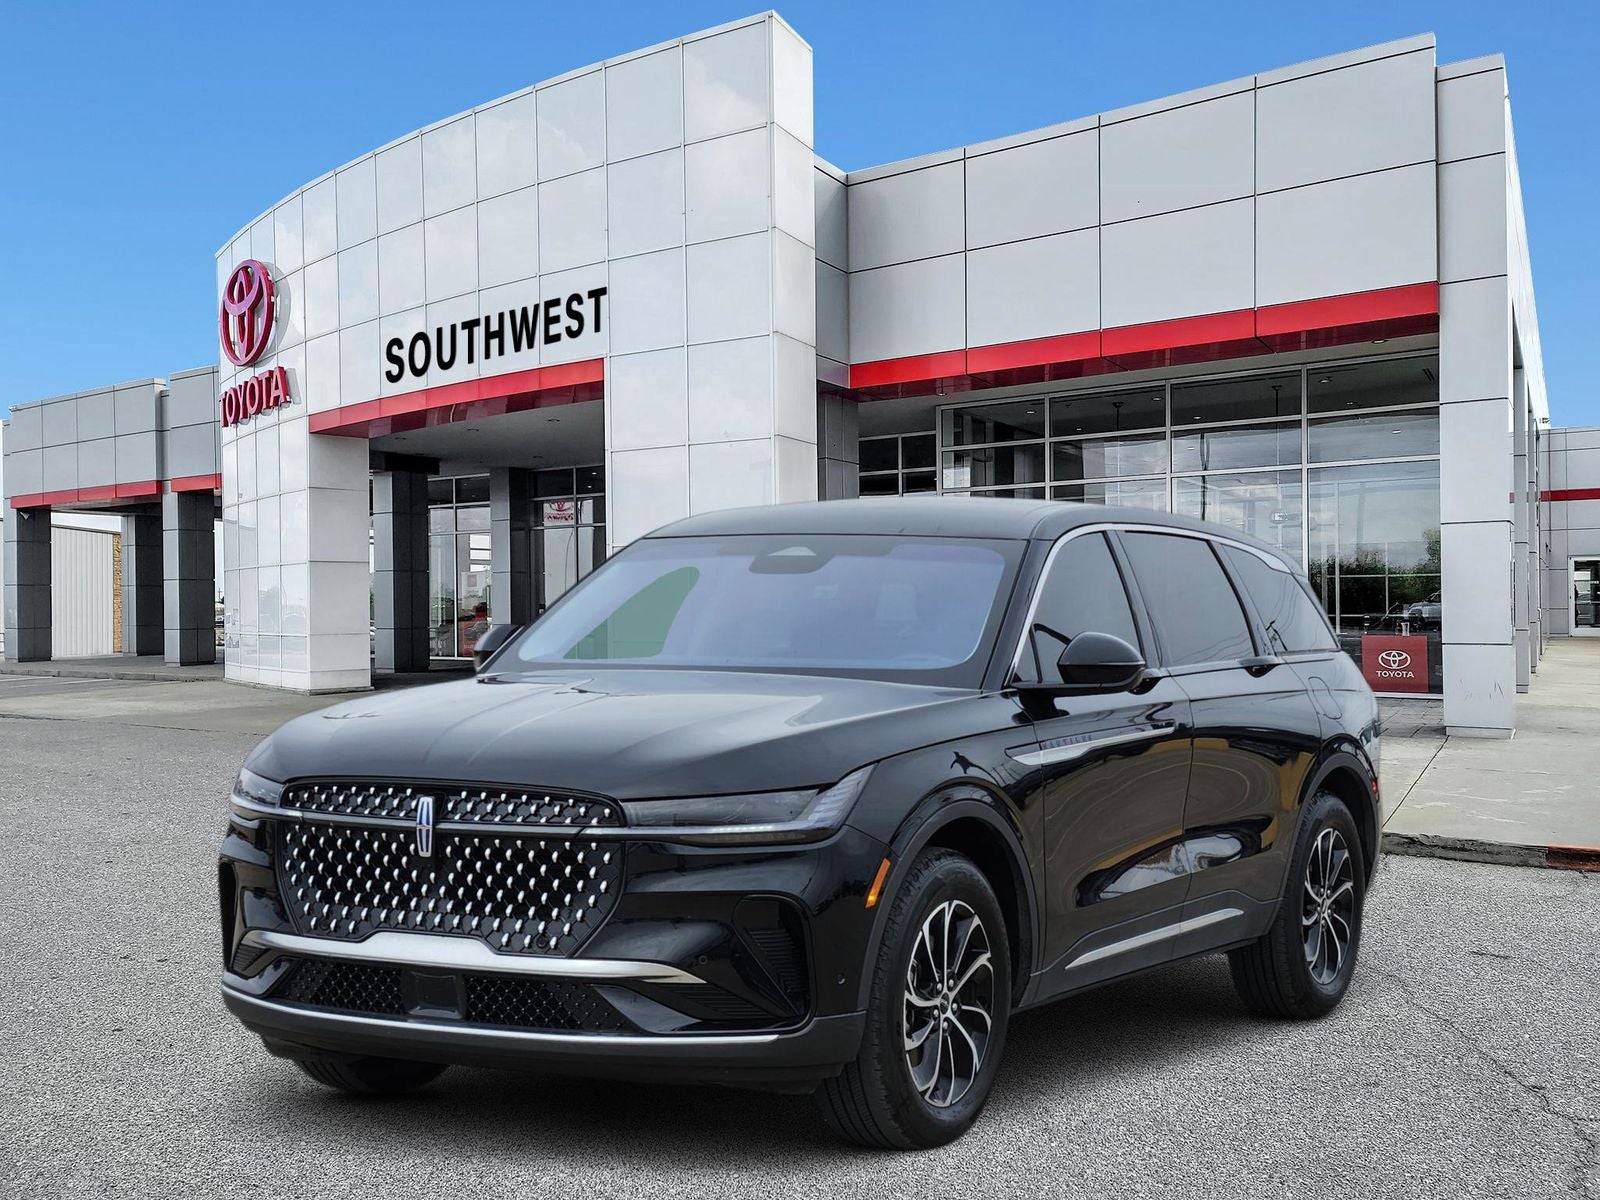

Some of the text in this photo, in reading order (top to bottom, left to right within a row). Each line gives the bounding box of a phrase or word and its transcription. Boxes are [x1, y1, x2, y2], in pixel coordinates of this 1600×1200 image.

[385, 286, 608, 384] SOUTHWEST
[218, 366, 290, 428] TOYOTA
[1375, 670, 1415, 679] TOYOTA
